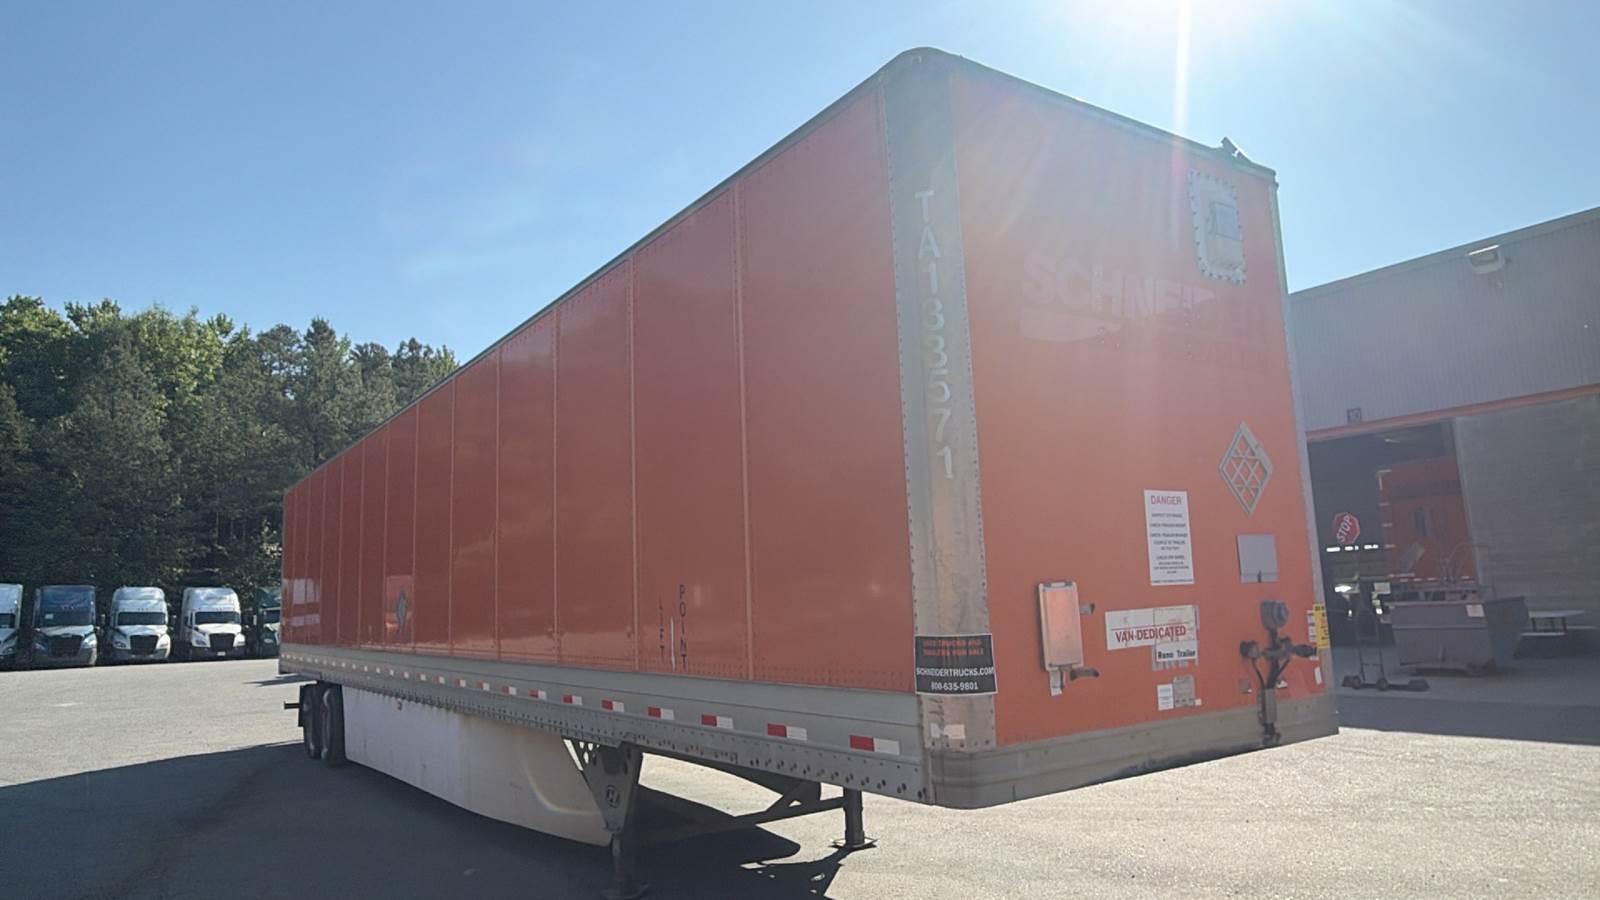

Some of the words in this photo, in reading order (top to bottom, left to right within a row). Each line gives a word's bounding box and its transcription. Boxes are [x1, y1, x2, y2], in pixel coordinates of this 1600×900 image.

[915, 190, 953, 479] TA133571
[1151, 495, 1182, 505] DANGER
[1336, 515, 1353, 543] STOP
[916, 667, 995, 677] SCHNEIDERTRUCKS.COM
